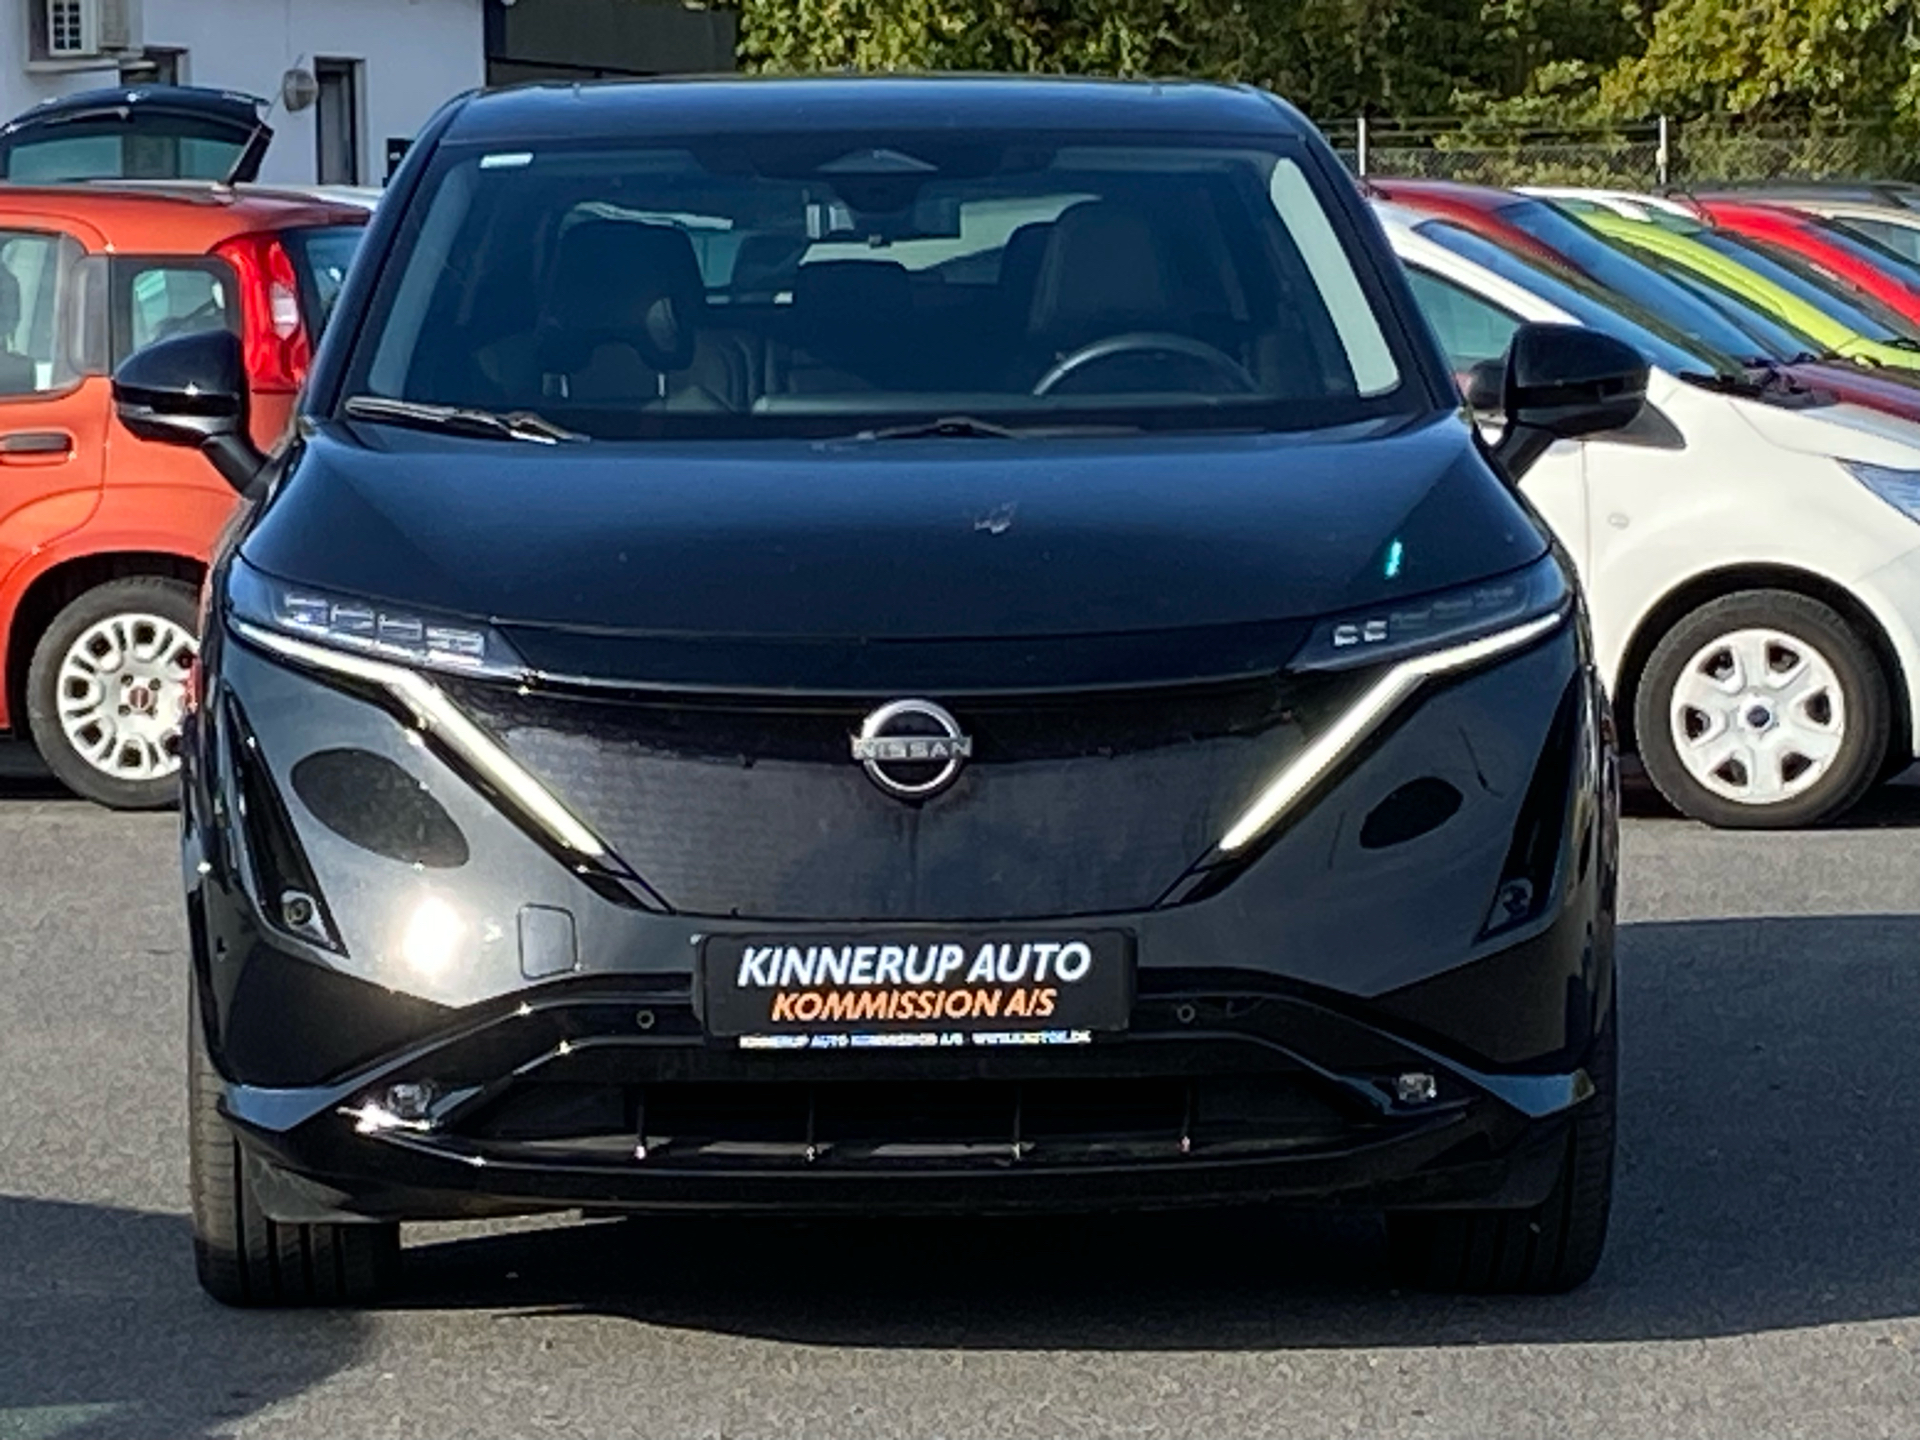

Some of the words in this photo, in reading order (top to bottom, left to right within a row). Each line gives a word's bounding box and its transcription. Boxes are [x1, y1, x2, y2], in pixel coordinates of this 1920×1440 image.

[852, 736, 972, 760] NISSAN
[737, 944, 964, 987] KINNERUP
[966, 942, 1091, 983] AUTO
[771, 989, 1001, 1021] KOMMISSION
[1004, 988, 1058, 1017] A/S
